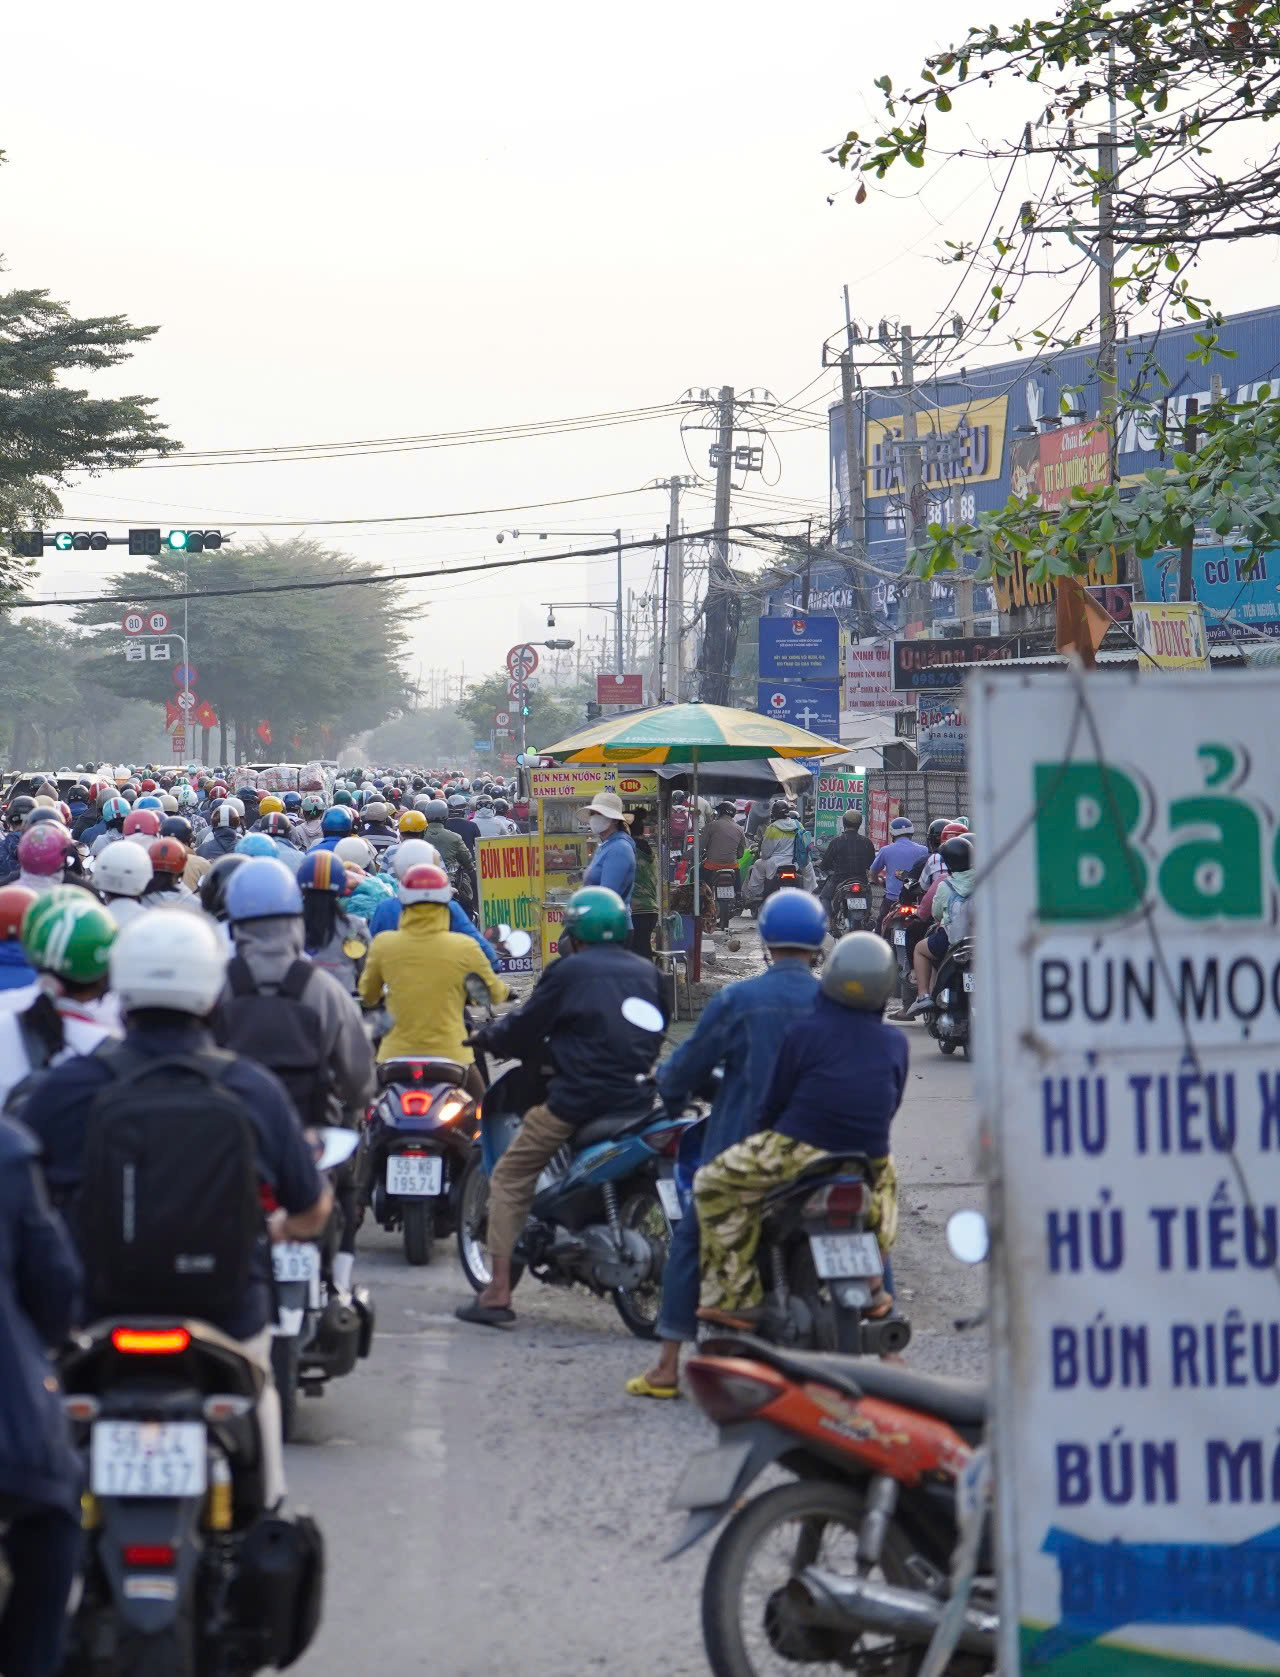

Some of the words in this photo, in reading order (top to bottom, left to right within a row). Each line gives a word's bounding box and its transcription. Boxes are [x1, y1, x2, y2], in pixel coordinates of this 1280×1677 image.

[1204, 557, 1230, 585] CƠ
[128, 618, 140, 629] 80
[153, 617, 164, 628] 60
[552, 771, 570, 783] NEM
[604, 771, 616, 781] 25K
[622, 780, 639, 790] 10K
[819, 775, 845, 793] SỬA
[847, 778, 865, 793] XE
[818, 792, 844, 811] RỬA
[847, 798, 863, 811] XE
[1033, 741, 1280, 922] Bả
[480, 842, 501, 879] BÚN
[503, 846, 525, 878] NEM
[509, 957, 532, 971] 093
[1040, 938, 1155, 1023] BÚN
[1178, 956, 1280, 1039] MỌ
[1042, 1050, 1109, 1158] HỦ
[1046, 1186, 1124, 1274] HỦ
[1149, 1178, 1278, 1273] TIẾU
[1051, 1309, 1151, 1390] BÚN
[1171, 1307, 1280, 1389] RIÊU
[1055, 1425, 1179, 1507] BÚN
